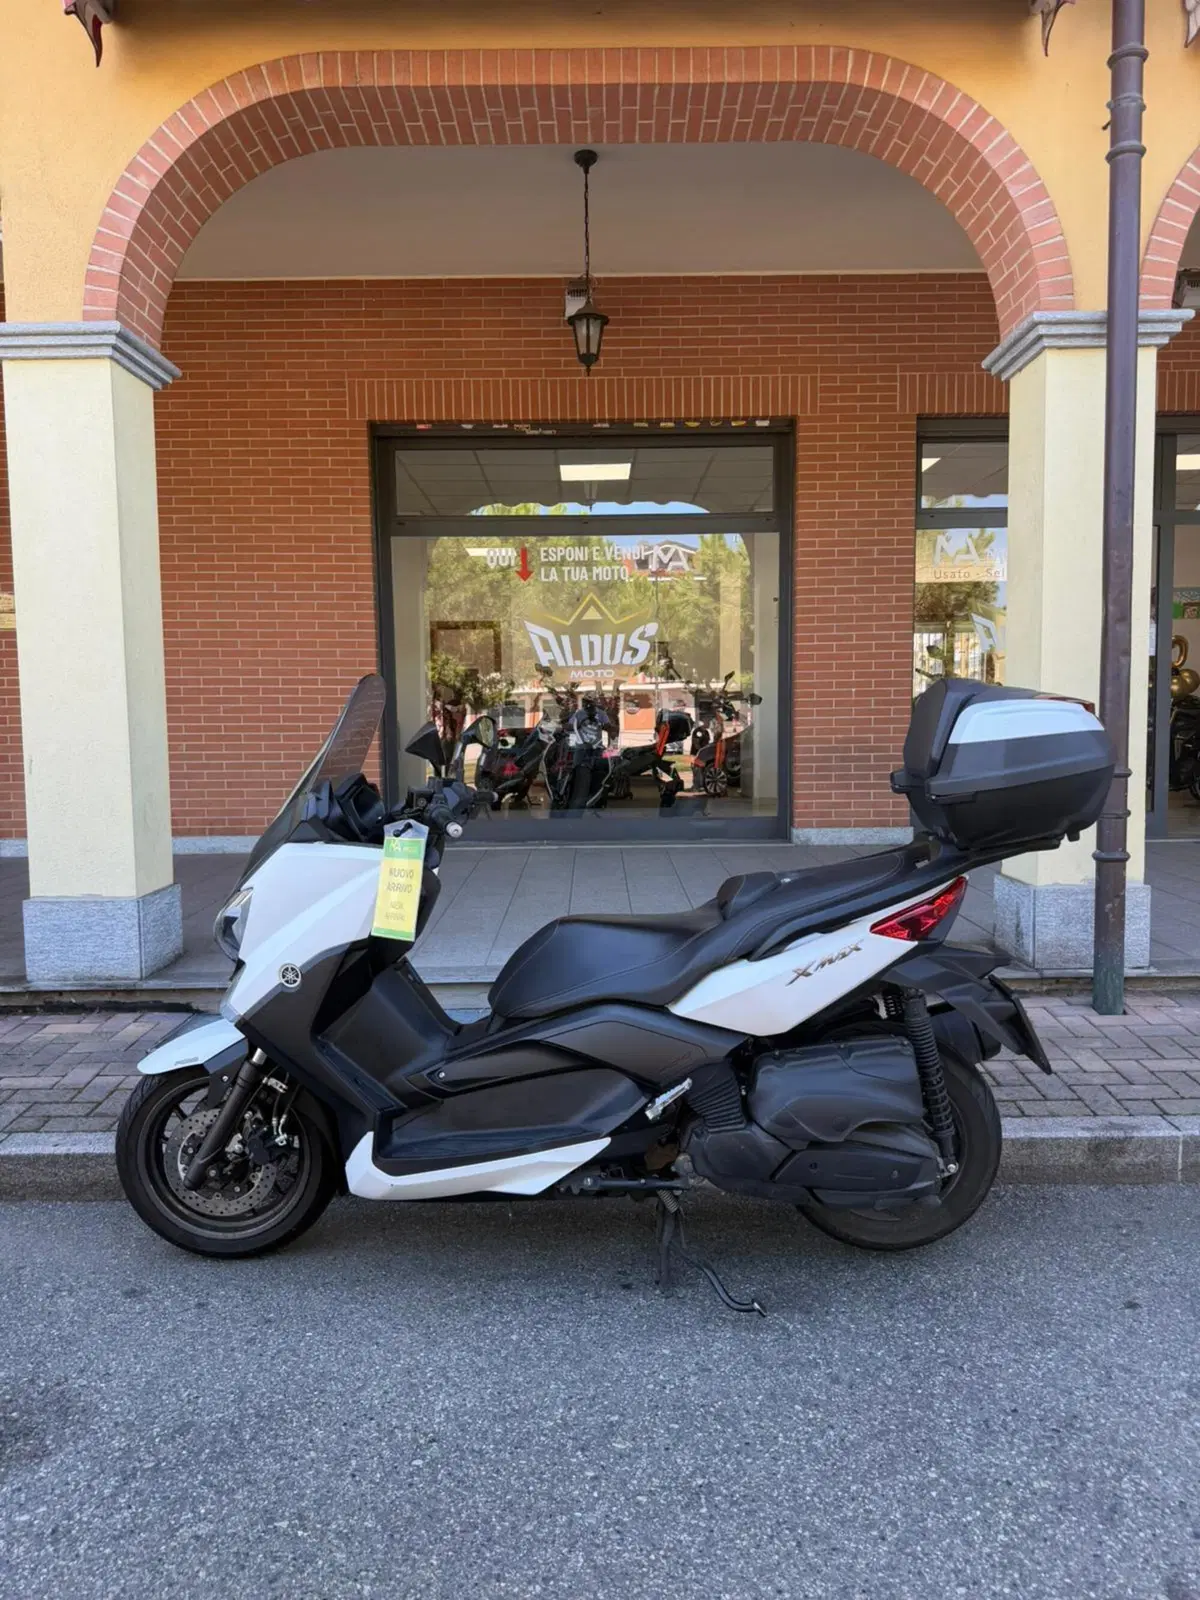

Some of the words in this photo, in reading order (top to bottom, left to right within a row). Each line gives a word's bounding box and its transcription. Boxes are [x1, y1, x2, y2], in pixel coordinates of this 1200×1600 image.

[486, 548, 516, 568] QUI
[540, 547, 588, 562] ESPONI
[592, 547, 600, 561] E
[604, 545, 645, 561] VENDI
[540, 567, 558, 582] LA
[562, 566, 588, 581] TUA
[592, 566, 629, 582] MOTO
[933, 569, 970, 580] Usato
[523, 620, 659, 667] ALDUS
[570, 669, 615, 679] MOTO
[388, 867, 415, 880] NUOVO
[386, 881, 413, 894] ARRIVO
